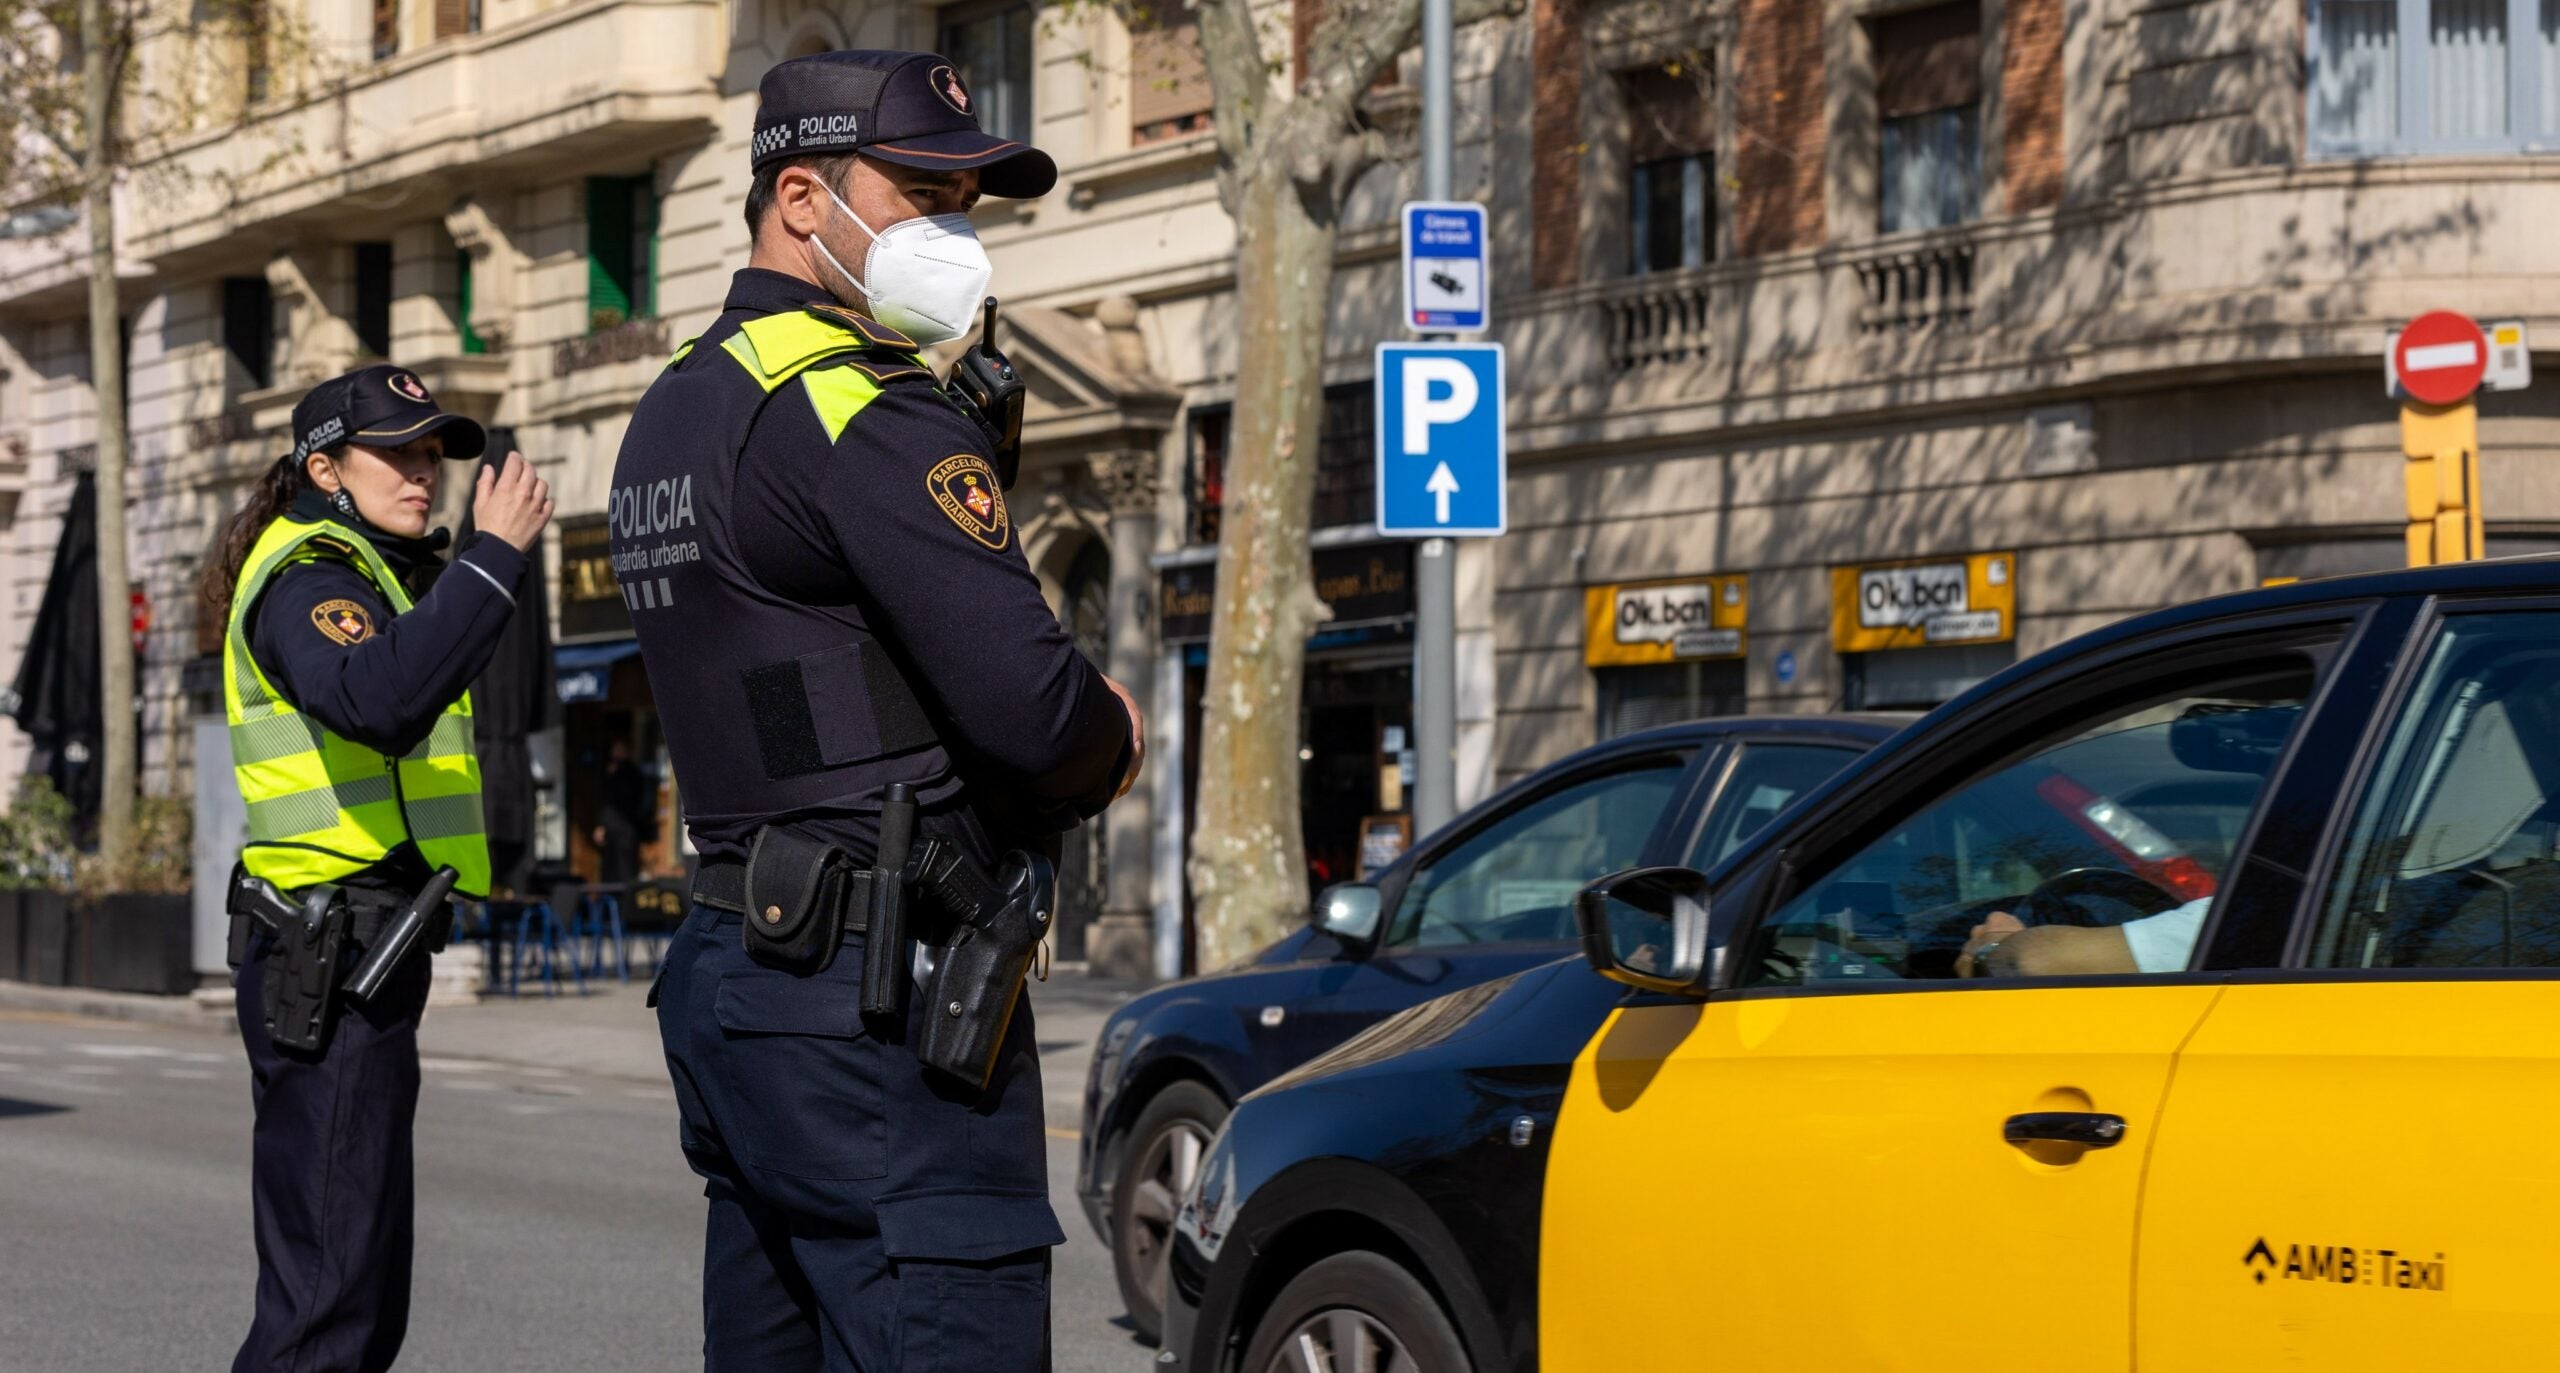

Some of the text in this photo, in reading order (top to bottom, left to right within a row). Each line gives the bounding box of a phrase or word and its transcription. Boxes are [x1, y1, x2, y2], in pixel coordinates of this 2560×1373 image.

[798, 115, 858, 136] POLICIA
[798, 133, 857, 147] Guàrdia Urbana
[1402, 357, 1479, 455] P
[308, 416, 343, 445] POLICIA
[932, 458, 989, 483] BARCELONA
[609, 474, 697, 540] POLICIA
[939, 492, 981, 535] GUARDIA
[650, 539, 701, 568] urbana
[1866, 575, 1962, 609] Ok.bcn
[1621, 596, 1706, 626] Ok.bcn
[2281, 1244, 2445, 1291] AMB Taxi
